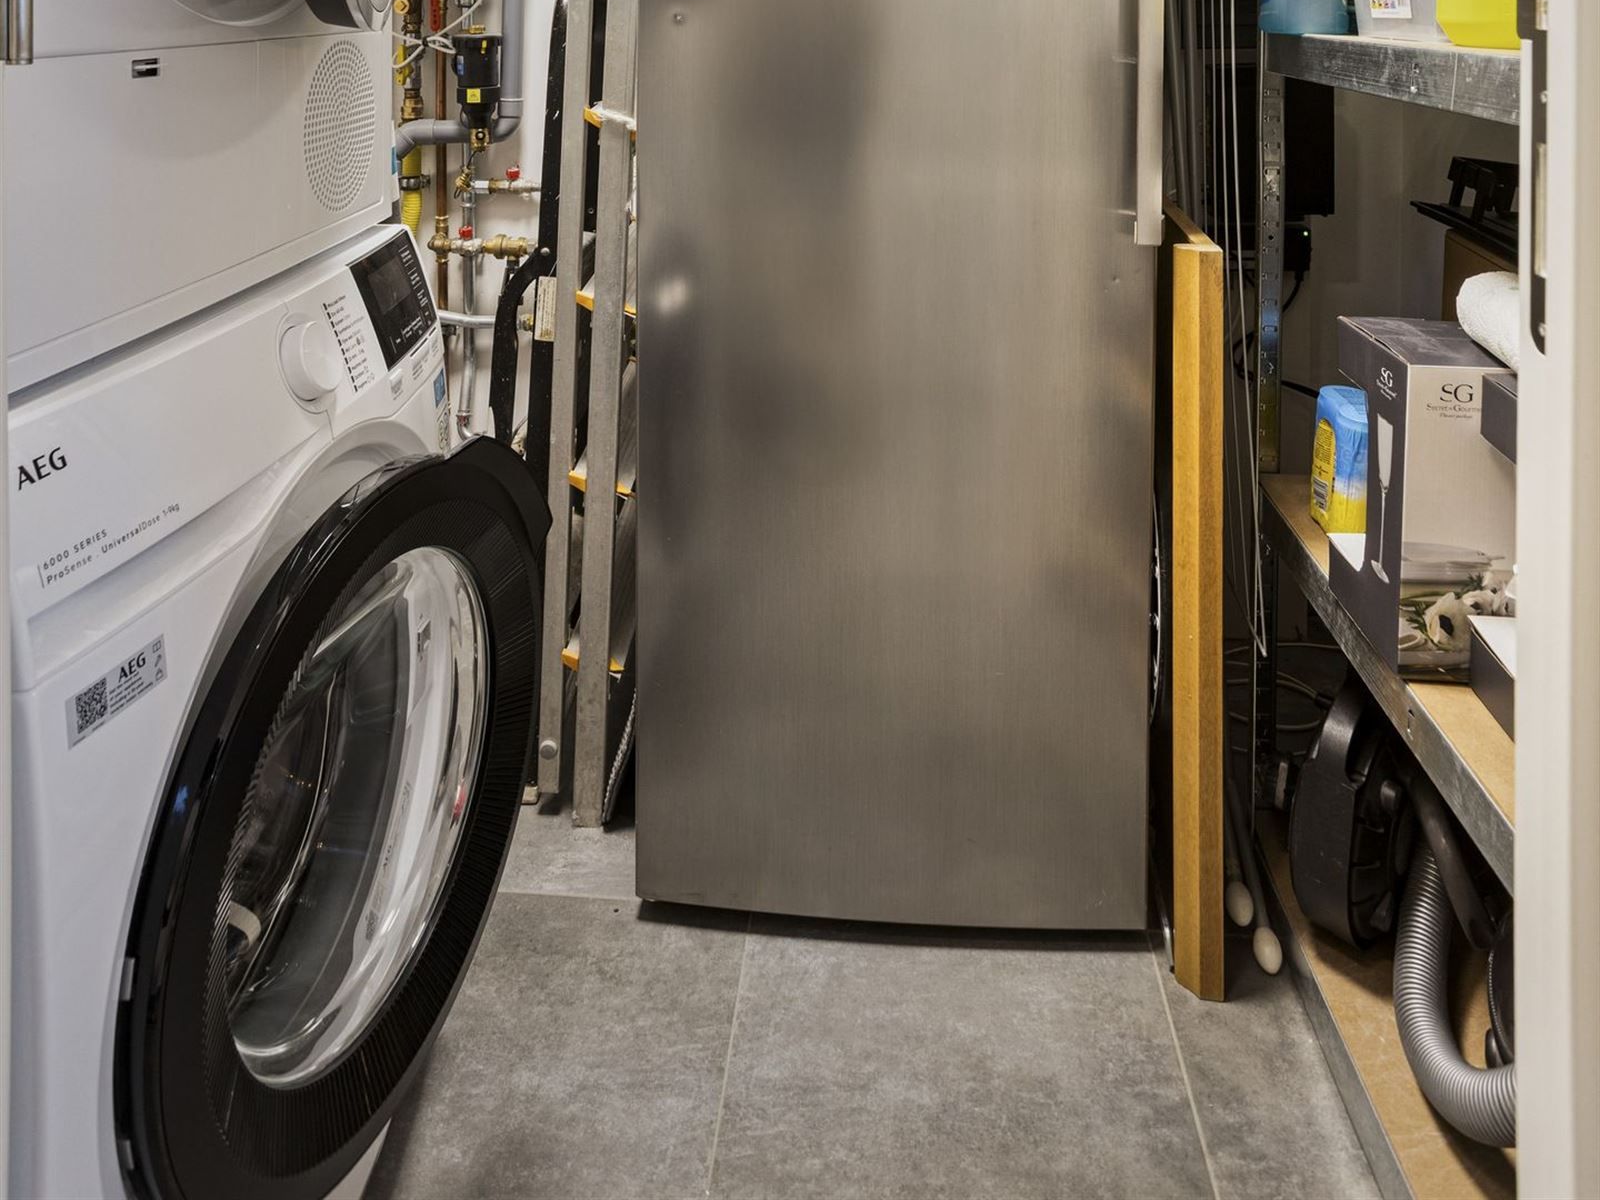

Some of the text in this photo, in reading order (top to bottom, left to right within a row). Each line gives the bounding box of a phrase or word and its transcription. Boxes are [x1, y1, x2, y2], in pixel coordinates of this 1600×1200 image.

[1439, 383, 1474, 404] SG
[17, 447, 69, 491] AEG
[43, 529, 108, 571] 6000 SERIES
[46, 555, 92, 584] ProSense
[101, 514, 161, 554] UniversalDose
[118, 651, 146, 684] AEG
